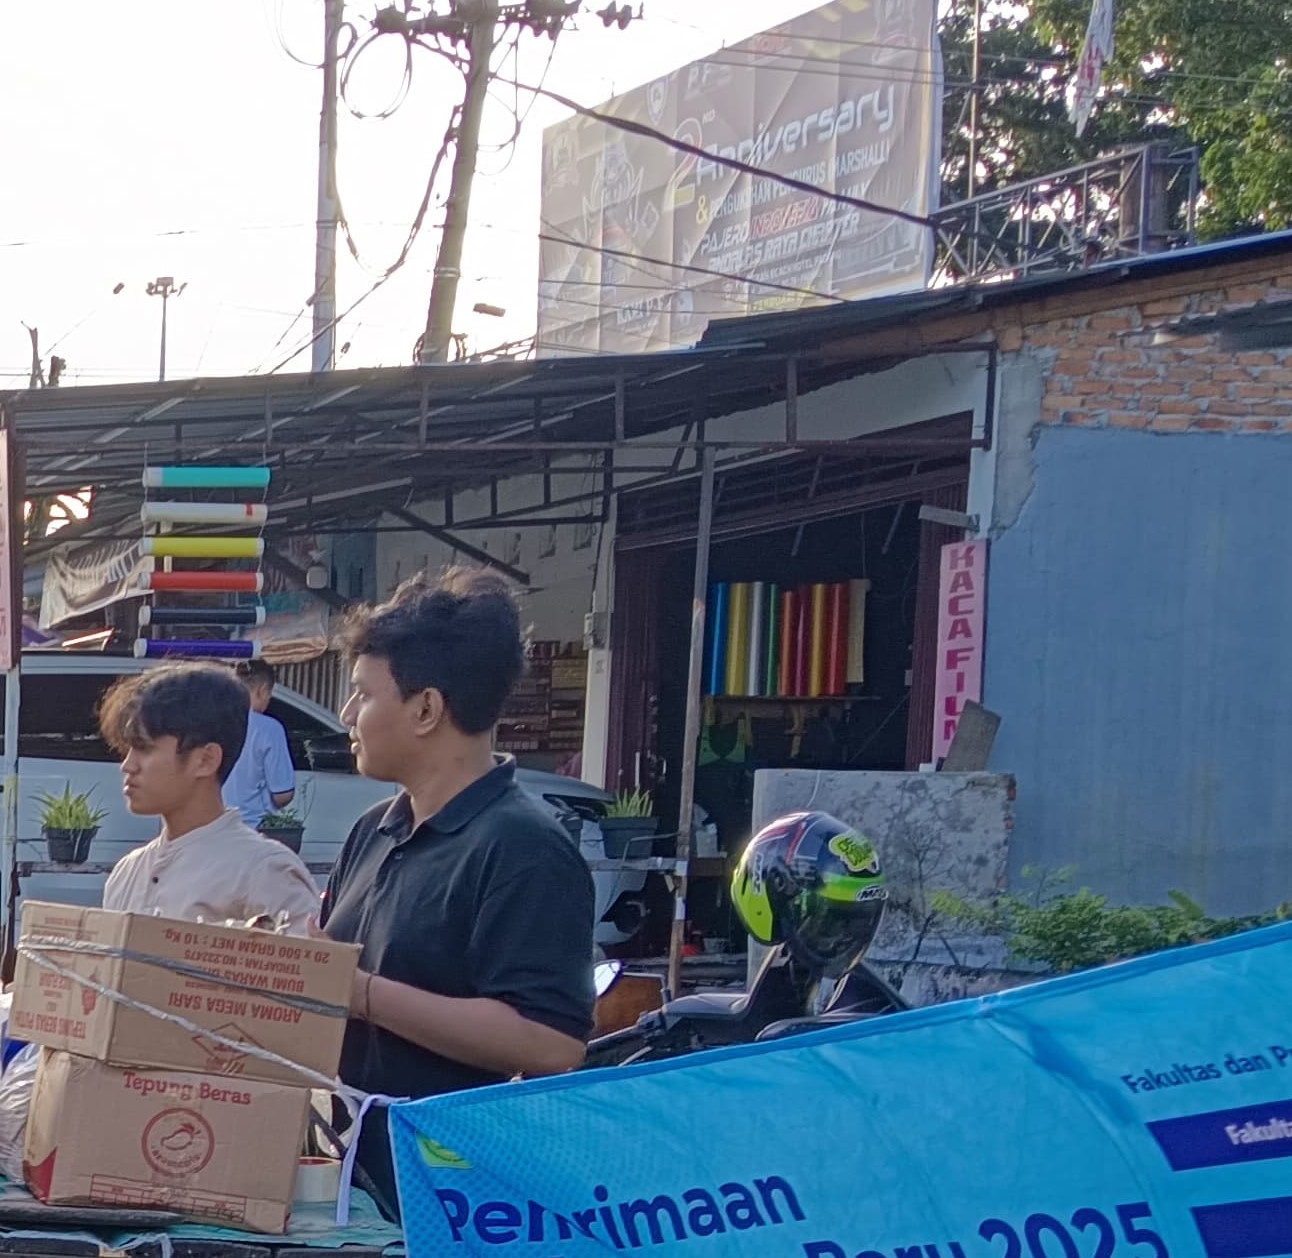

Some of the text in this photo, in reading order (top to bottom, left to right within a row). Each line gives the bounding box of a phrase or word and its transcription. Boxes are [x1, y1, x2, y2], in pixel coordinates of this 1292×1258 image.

[695, 86, 895, 187] Anniversary
[696, 195, 709, 224] &
[947, 545, 976, 640] KACA
[186, 931, 202, 945] 10
[209, 935, 236, 951] NET
[237, 939, 275, 957] GRAM
[276, 945, 303, 959] 500
[313, 950, 330, 964] 20
[247, 959, 302, 976] TERDAFTAR
[272, 977, 305, 993] BUMI
[168, 991, 303, 1024] AROMA MEGA SARI
[1119, 1060, 1223, 1094] Fakultas
[1224, 1050, 1273, 1077] dan
[123, 1071, 193, 1101] Tepung
[199, 1082, 252, 1106] Beras
